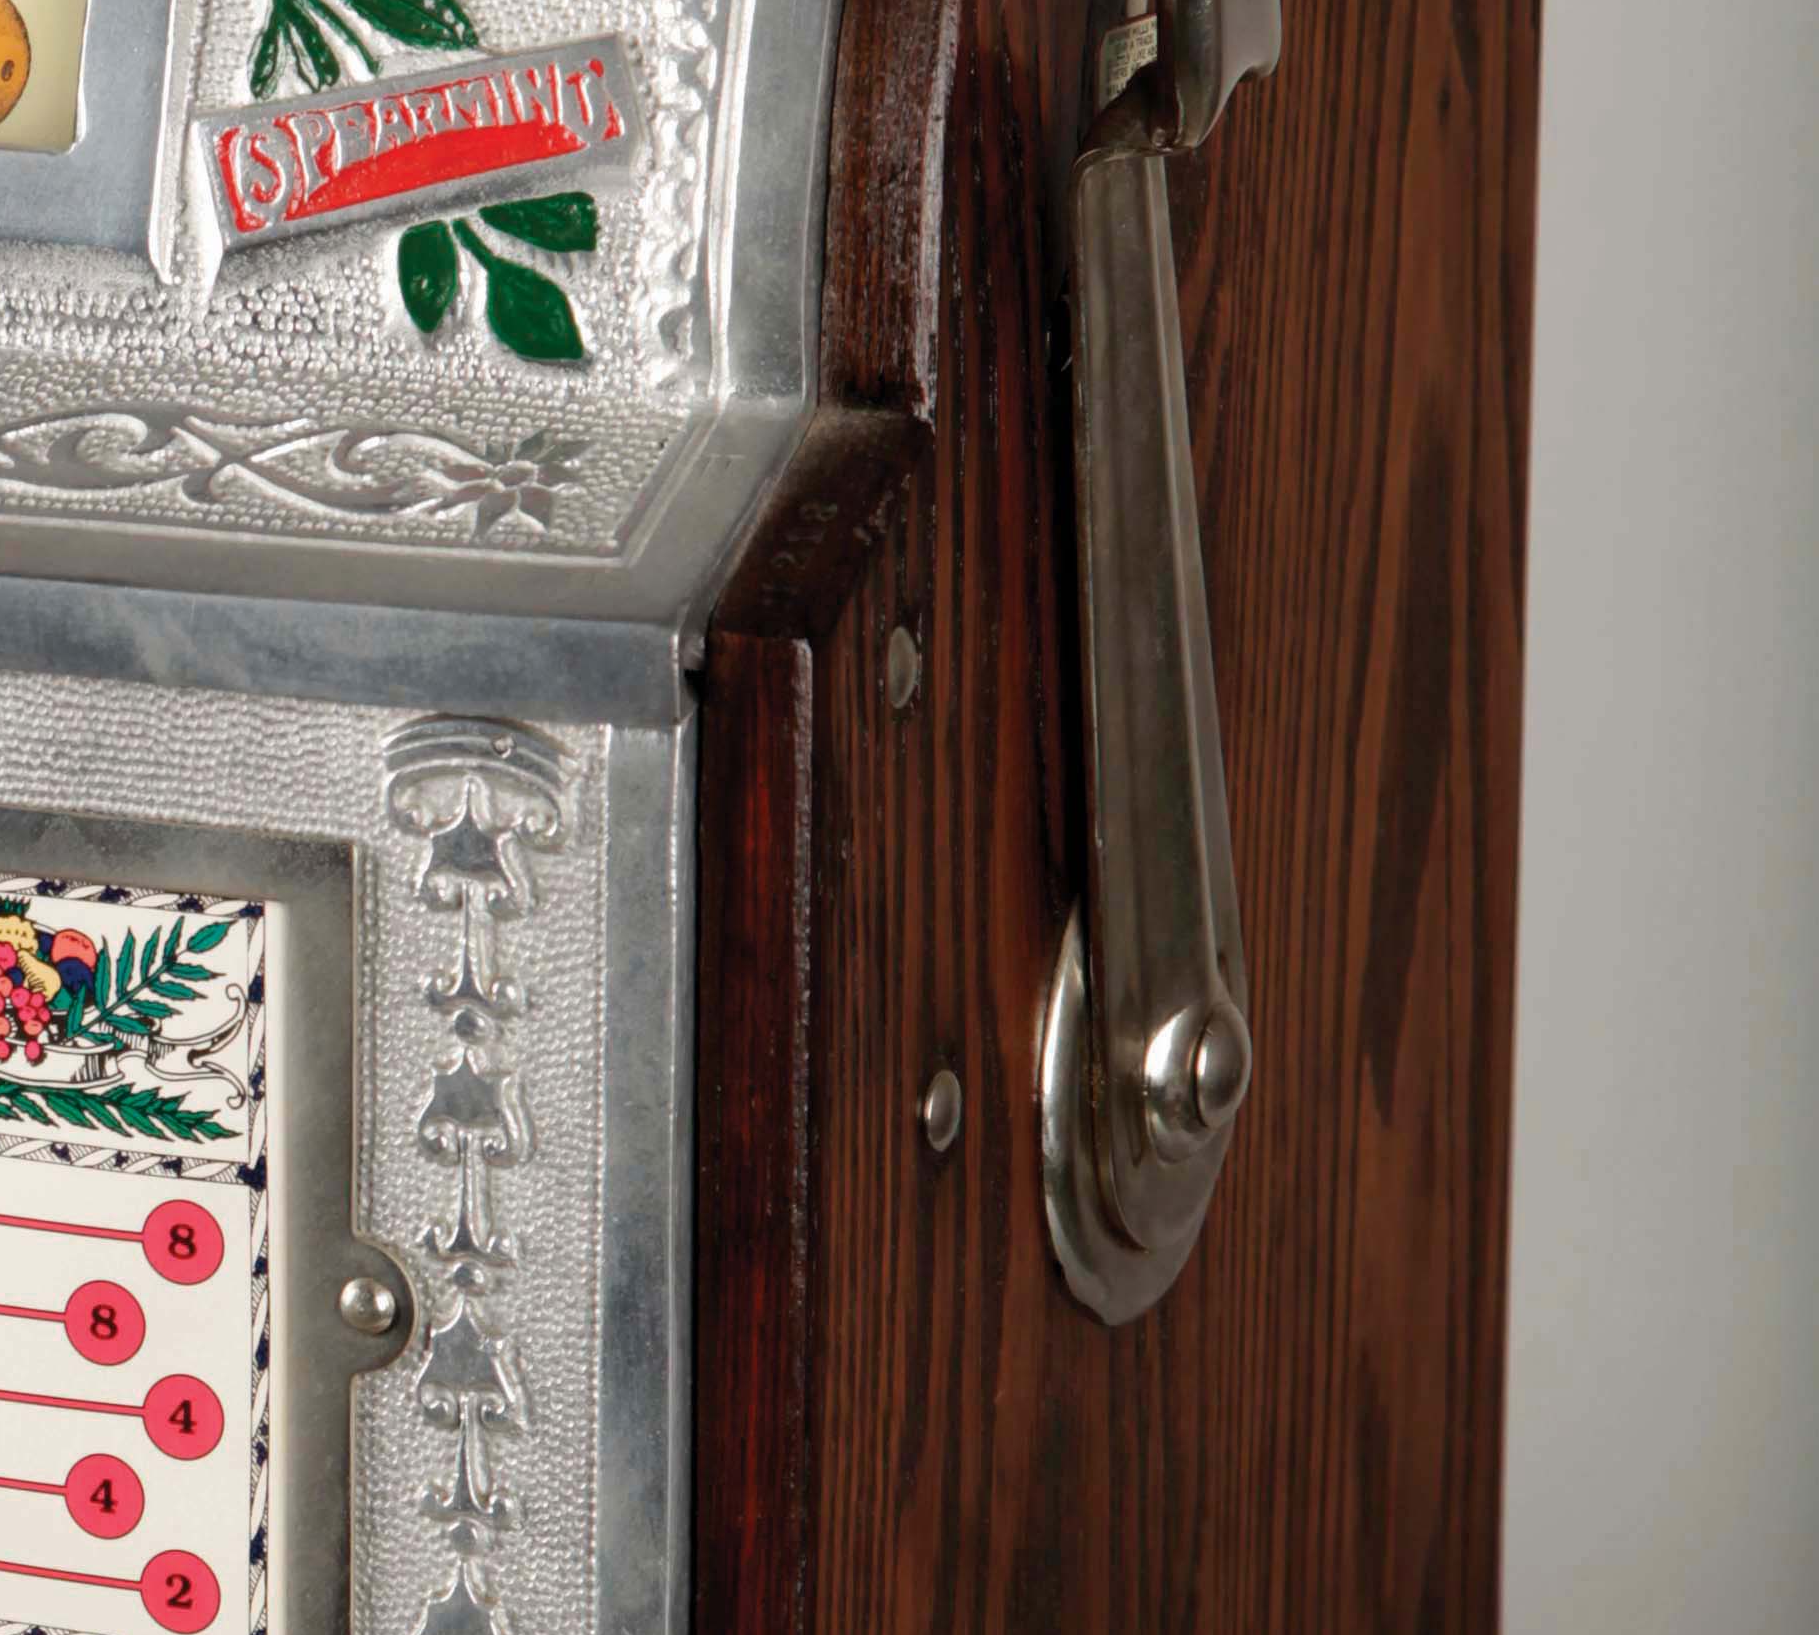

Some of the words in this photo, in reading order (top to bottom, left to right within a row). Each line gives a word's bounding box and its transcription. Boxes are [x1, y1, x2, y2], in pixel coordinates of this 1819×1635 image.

[167, 1223, 198, 1261] 8
[89, 1304, 119, 1341] 8
[168, 1399, 198, 1435] 4
[89, 1478, 119, 1514] 4
[165, 1573, 194, 1610] 2
